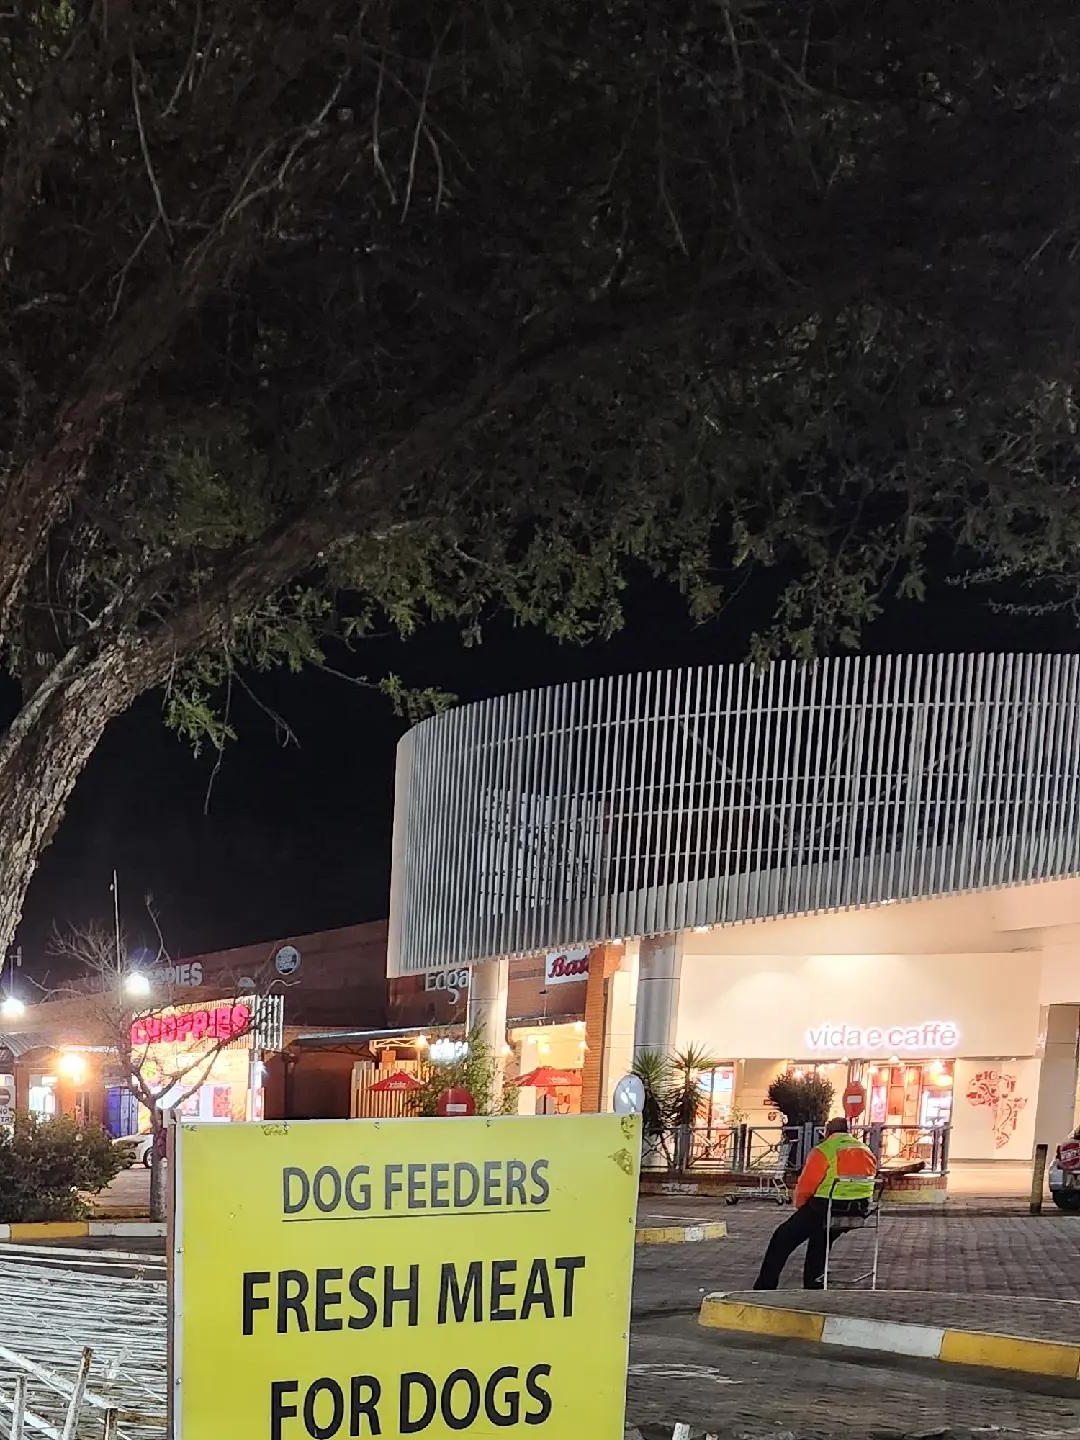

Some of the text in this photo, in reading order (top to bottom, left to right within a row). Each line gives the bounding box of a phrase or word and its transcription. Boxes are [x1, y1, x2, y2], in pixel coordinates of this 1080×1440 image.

[425, 969, 469, 1005] Edga
[548, 954, 589, 978] Bat
[131, 1003, 251, 1046] CHOPPIES
[809, 1024, 861, 1047] vida
[867, 1028, 882, 1047] e
[283, 1159, 551, 1214] DOG FEEDERS
[242, 1255, 587, 1336] FRESH MEAT
[399, 1363, 554, 1435] DOGS
